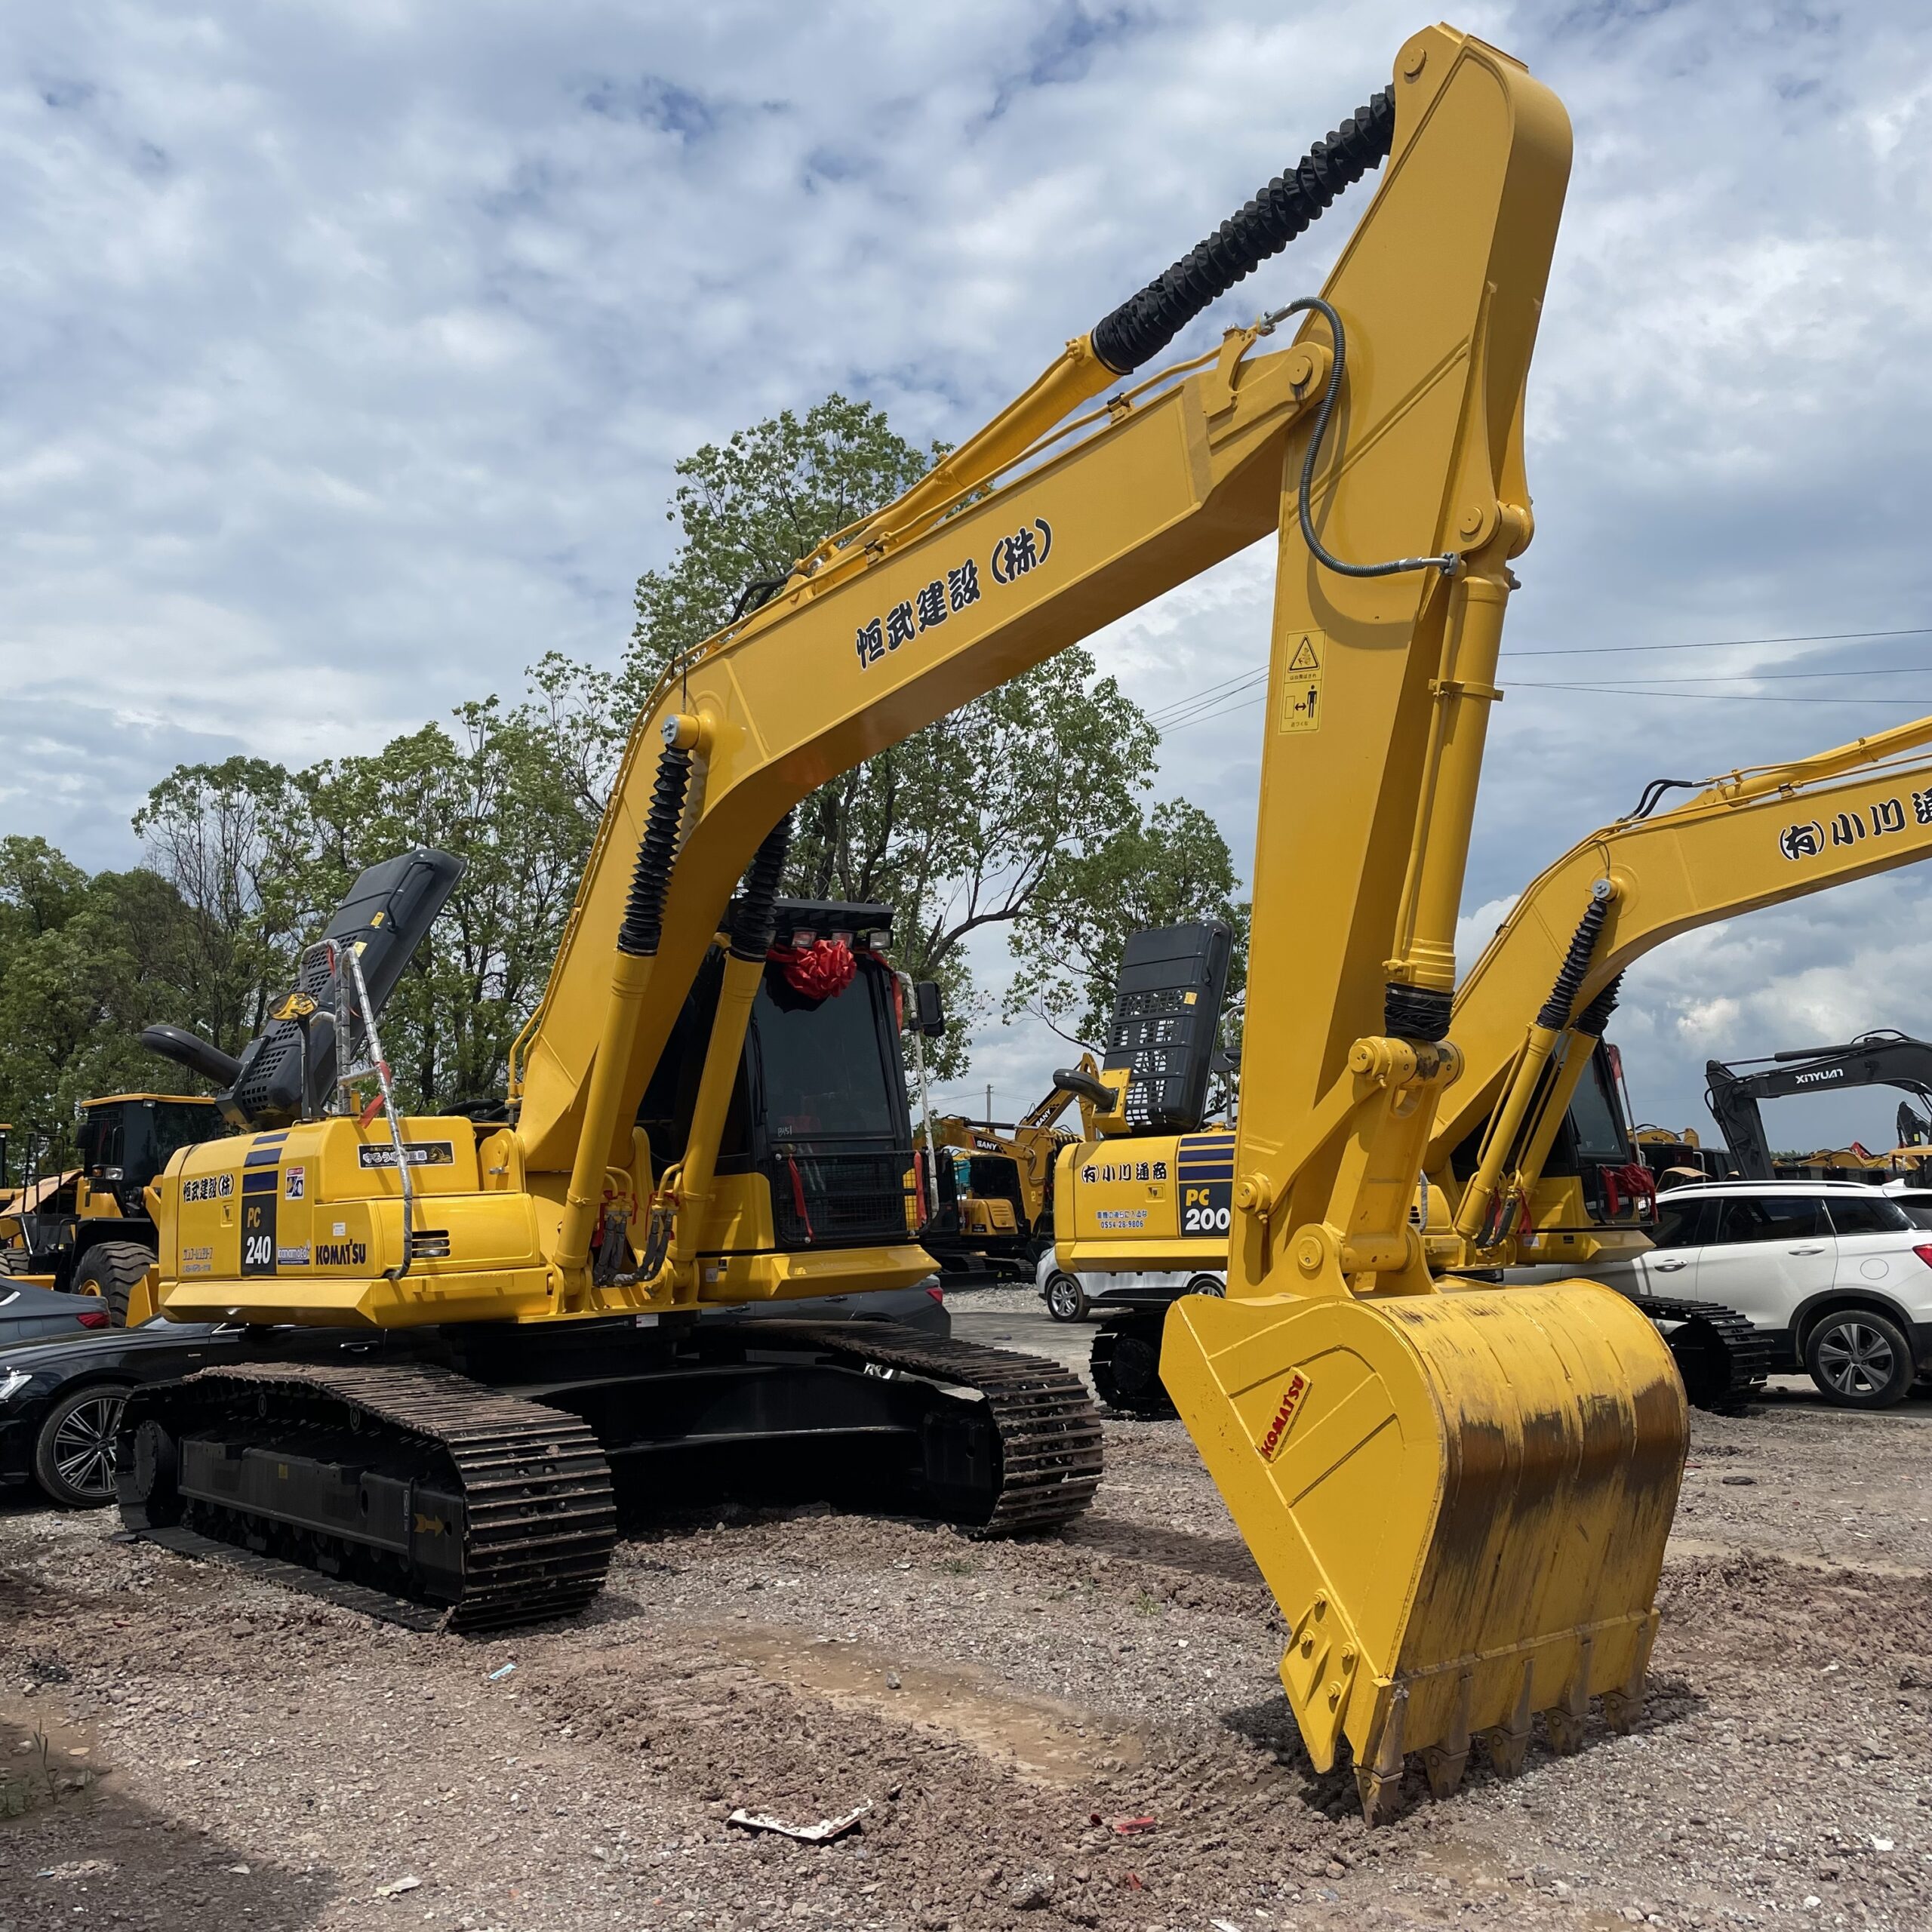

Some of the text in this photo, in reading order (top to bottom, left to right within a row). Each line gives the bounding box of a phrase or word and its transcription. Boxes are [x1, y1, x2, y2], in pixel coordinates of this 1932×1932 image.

[977, 1140, 997, 1150] SANY
[1186, 1189, 1210, 1206] PC
[247, 1208, 261, 1228] PC
[1185, 1208, 1231, 1230] 200
[245, 1236, 272, 1264] 240
[315, 1238, 366, 1266] KOMATSU
[1260, 1374, 1304, 1459] KOMATSU
